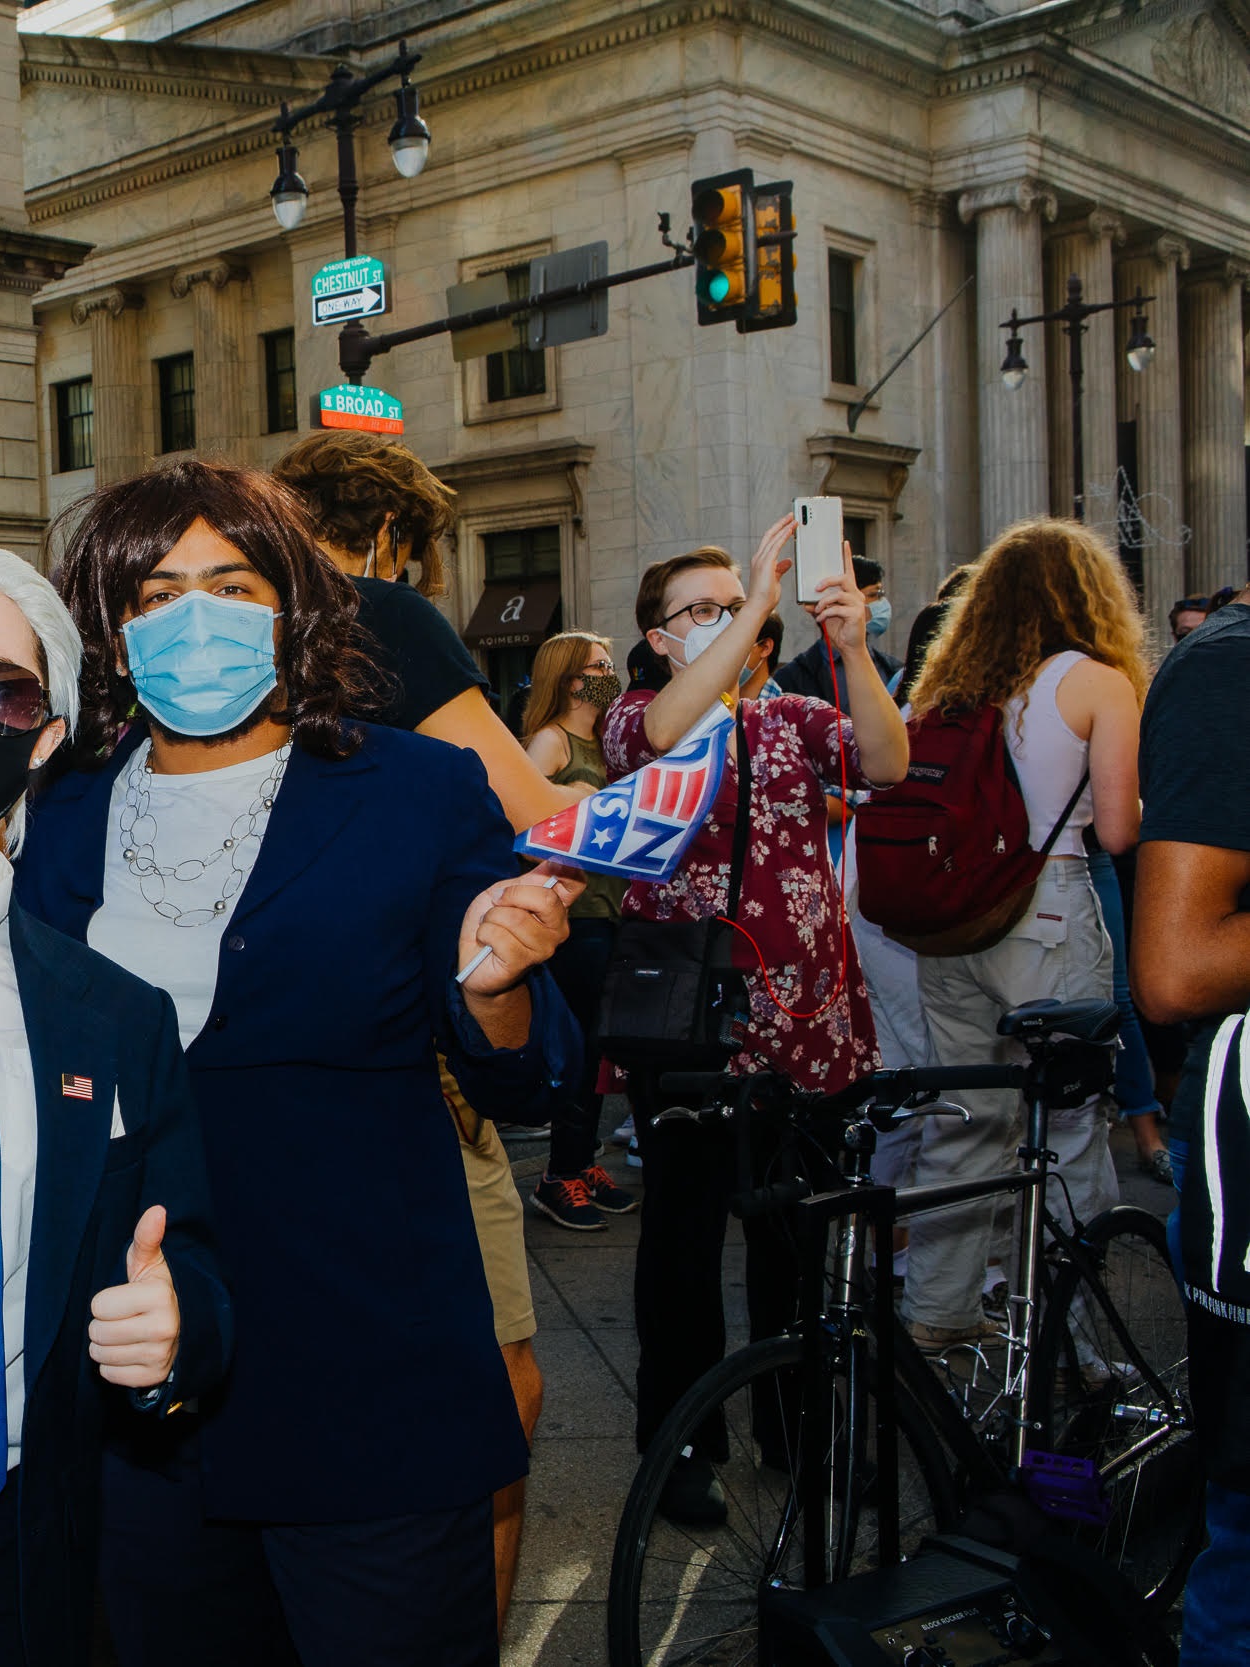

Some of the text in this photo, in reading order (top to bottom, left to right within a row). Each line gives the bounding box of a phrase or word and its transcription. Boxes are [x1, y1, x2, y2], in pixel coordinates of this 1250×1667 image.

[343, 260, 351, 269] W
[315, 267, 382, 295] CHESTNUT ST
[321, 295, 362, 314] ONE WAY
[359, 386, 365, 396] S
[336, 395, 399, 418] BROAD ST
[500, 595, 525, 623] a
[478, 634, 530, 646] AQIMERO
[921, 1619, 941, 1632] BLOCK
